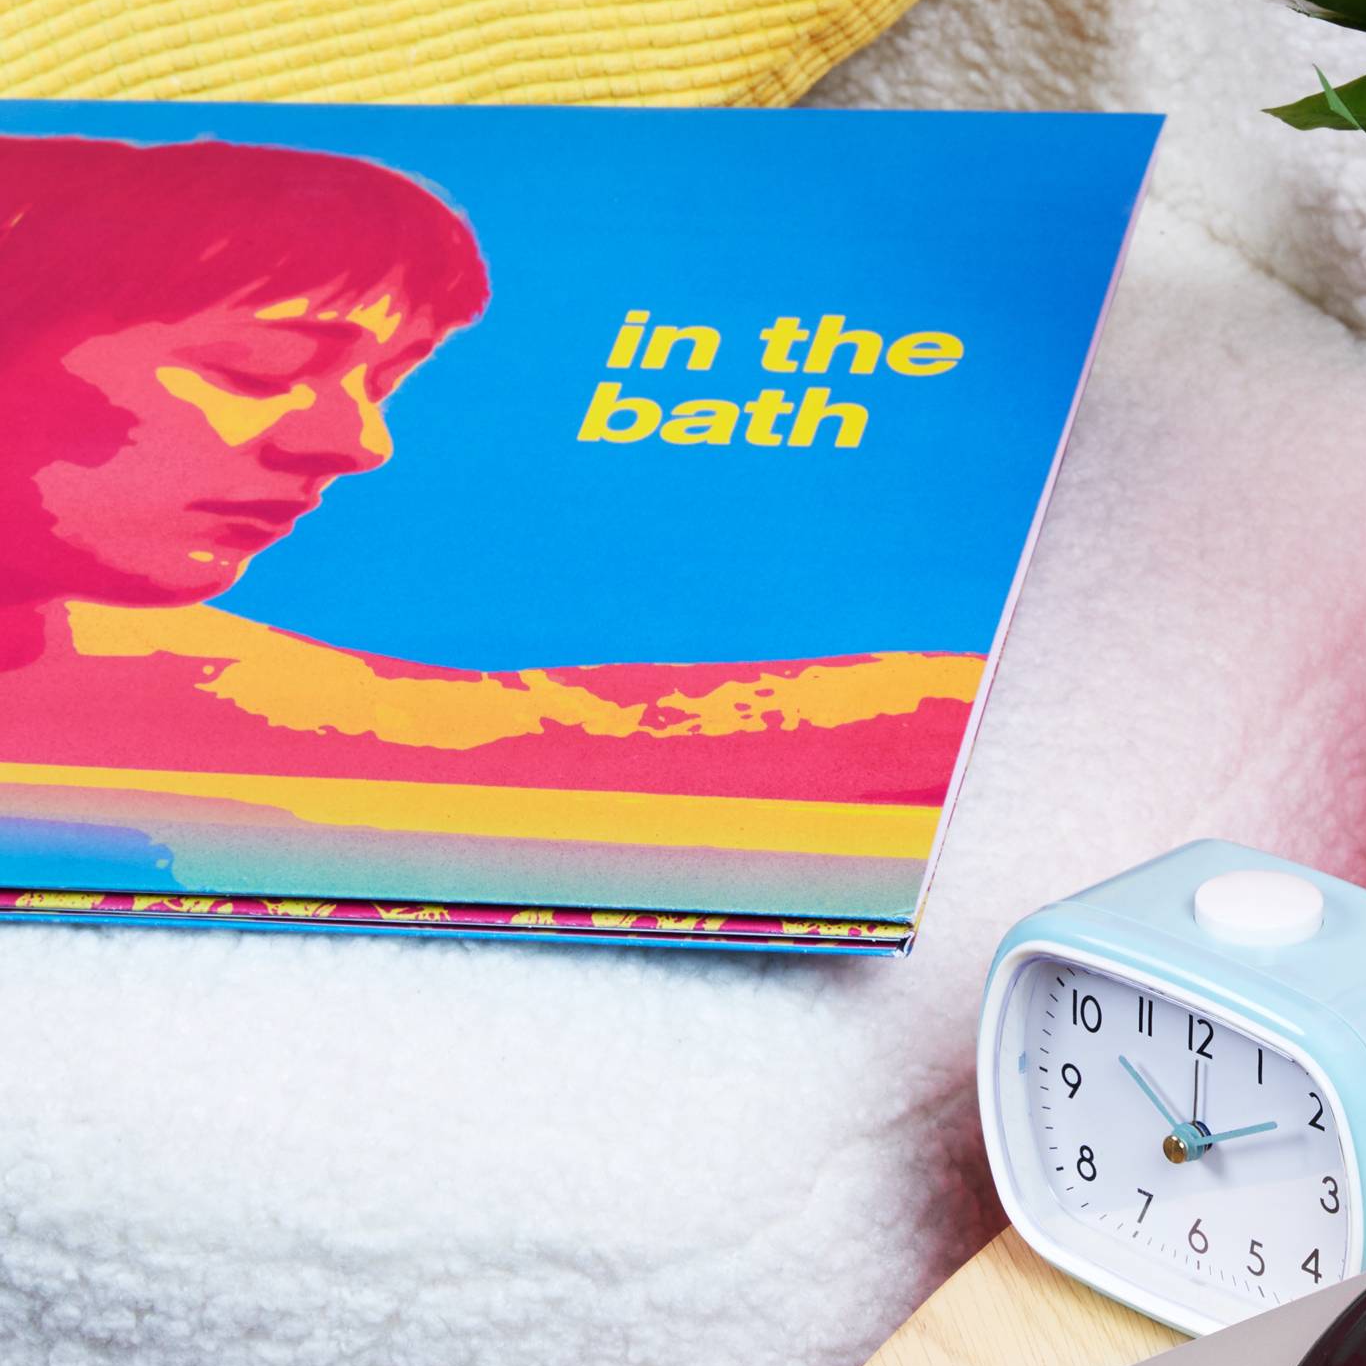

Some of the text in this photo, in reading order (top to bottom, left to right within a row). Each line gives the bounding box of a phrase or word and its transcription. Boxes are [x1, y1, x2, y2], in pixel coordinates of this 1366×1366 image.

[606, 309, 965, 377] in the
[576, 380, 870, 449] bath
[1071, 988, 1103, 1034] 10
[1138, 995, 1154, 1037] 11
[1188, 1014, 1215, 1060] 12
[1060, 1062, 1083, 1099] 9
[1257, 1048, 1264, 1085] 1
[1308, 1092, 1327, 1132] 2
[1076, 1144, 1098, 1182] 8
[1136, 1187, 1154, 1224] 7
[1319, 1176, 1340, 1215] 3
[1188, 1218, 1210, 1255] 6
[1246, 1239, 1266, 1277] 5
[1300, 1248, 1323, 1284] 4
